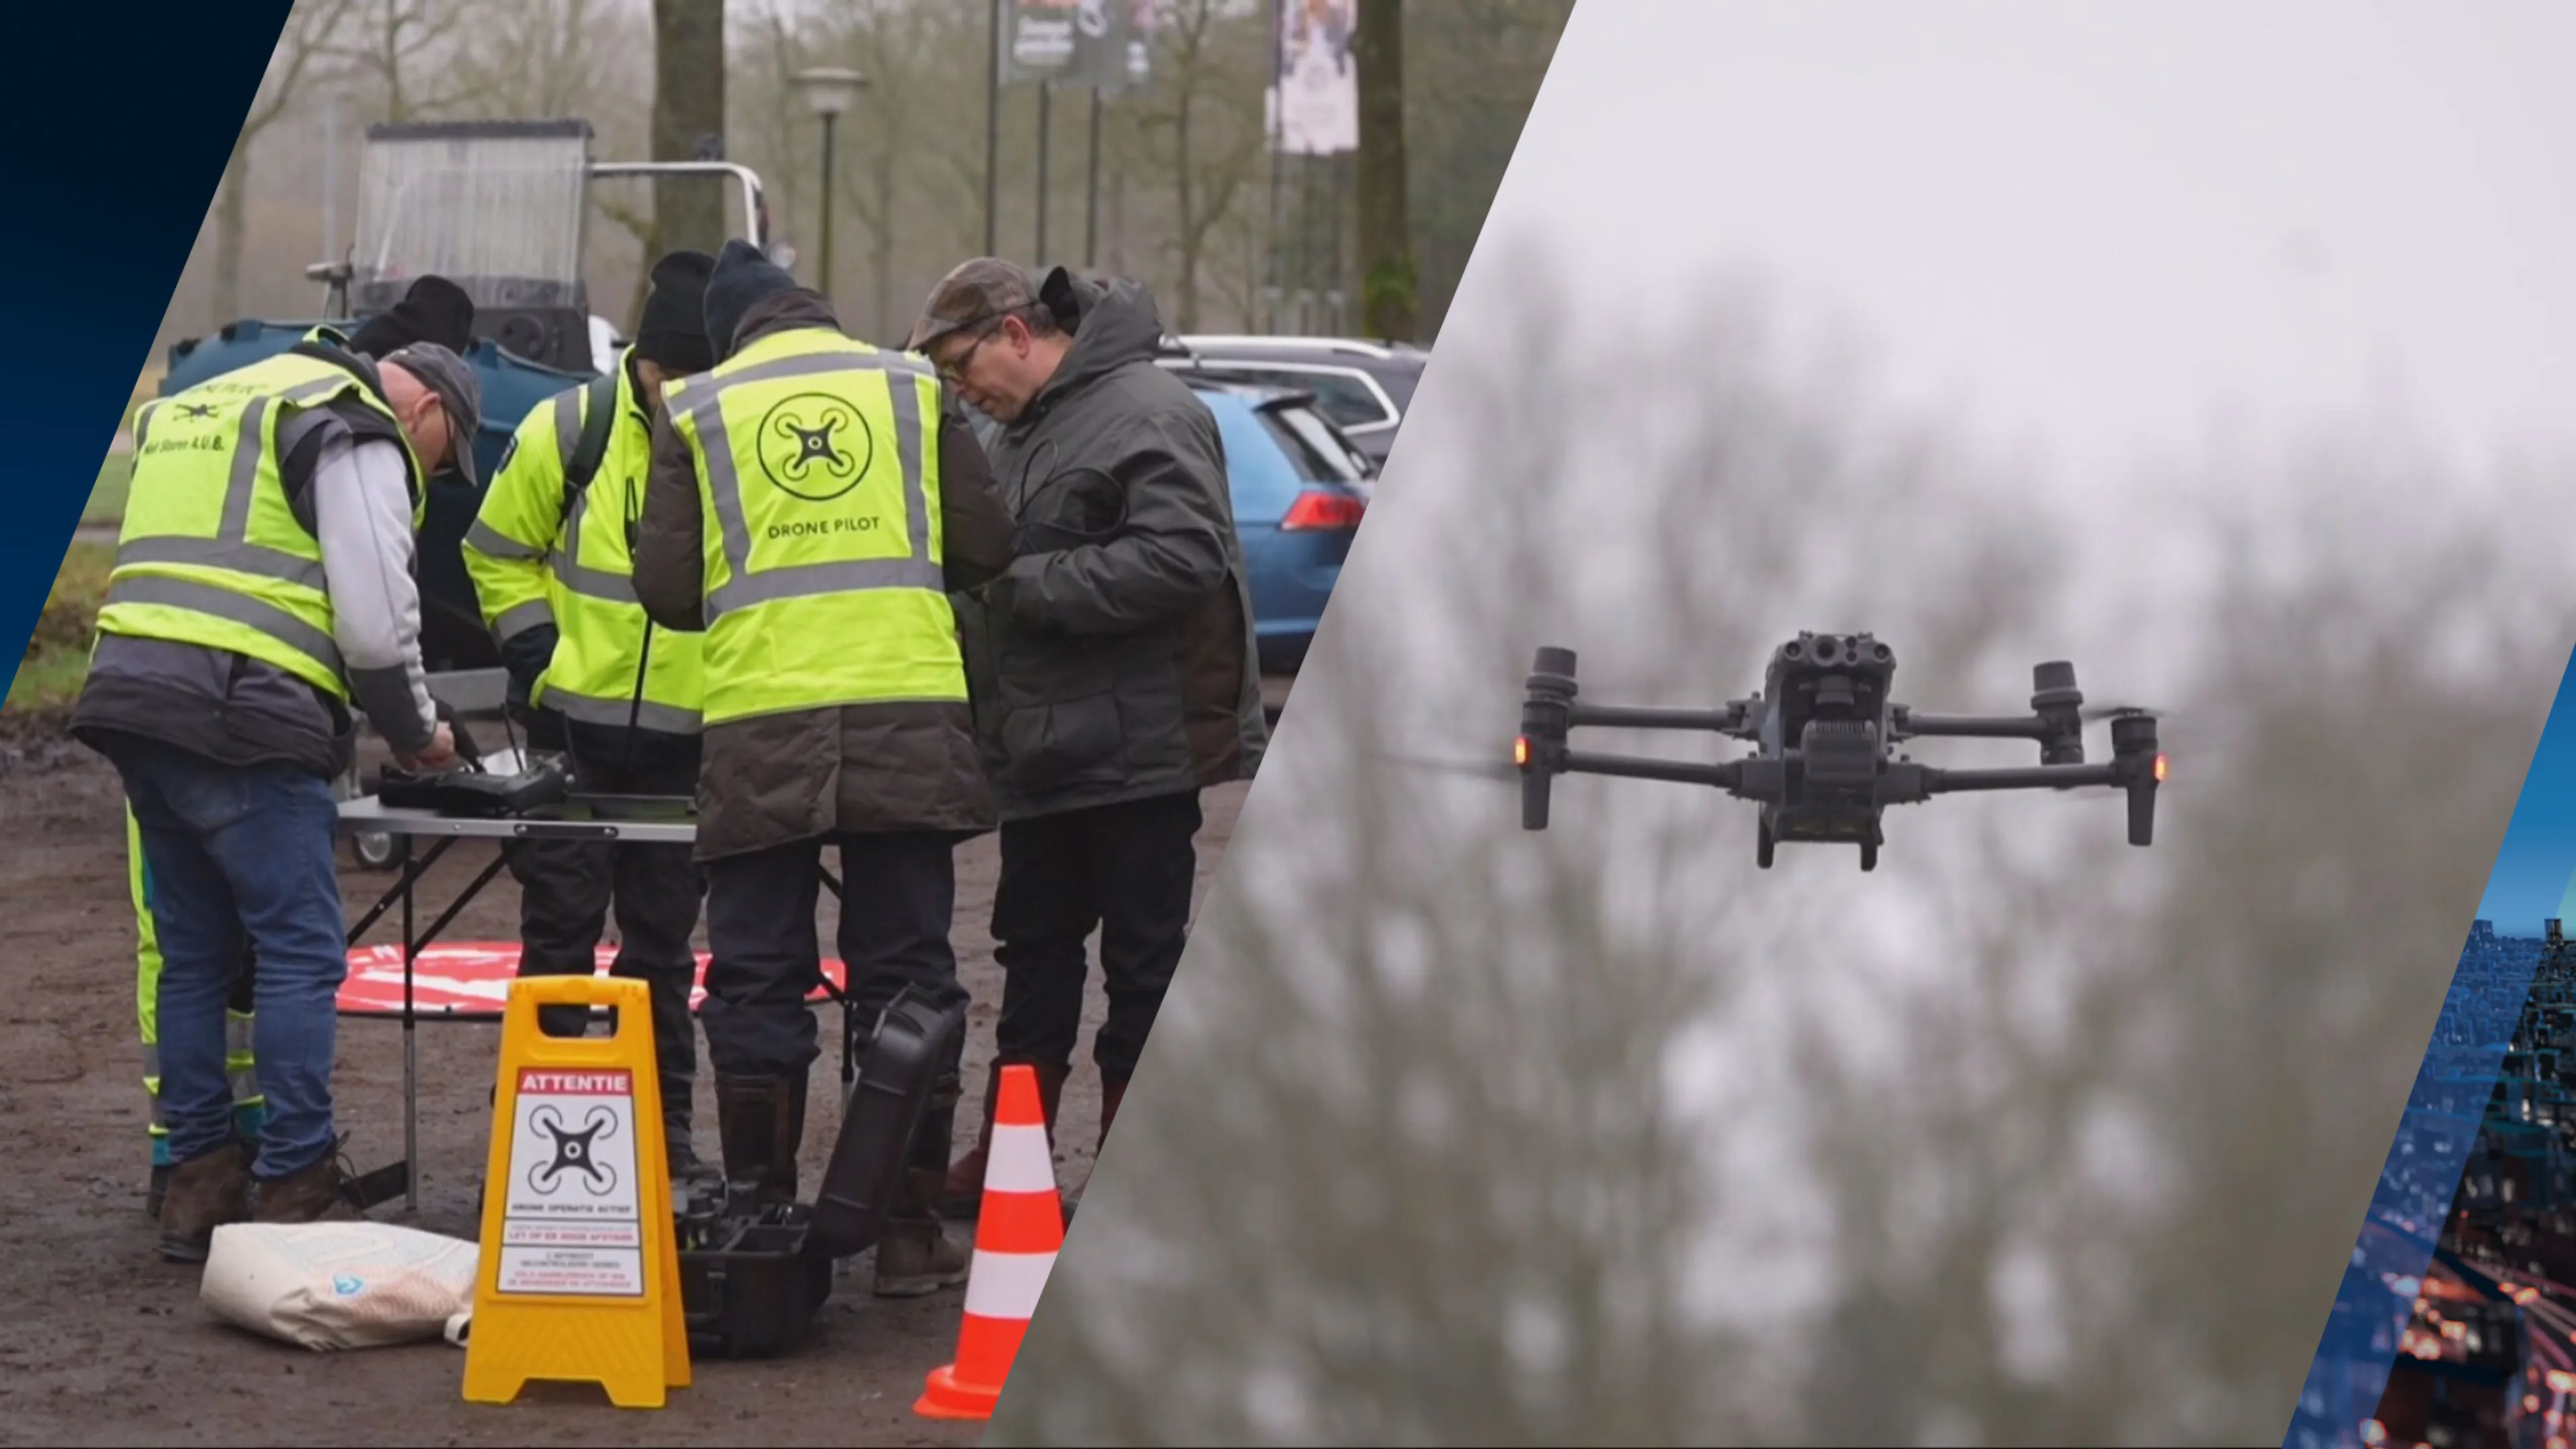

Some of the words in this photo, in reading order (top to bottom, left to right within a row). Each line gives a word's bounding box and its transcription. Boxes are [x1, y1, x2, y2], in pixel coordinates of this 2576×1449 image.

[768, 520, 828, 539] DRONE
[834, 516, 880, 532] PILOT
[522, 1073, 629, 1092] ATTENTIE
